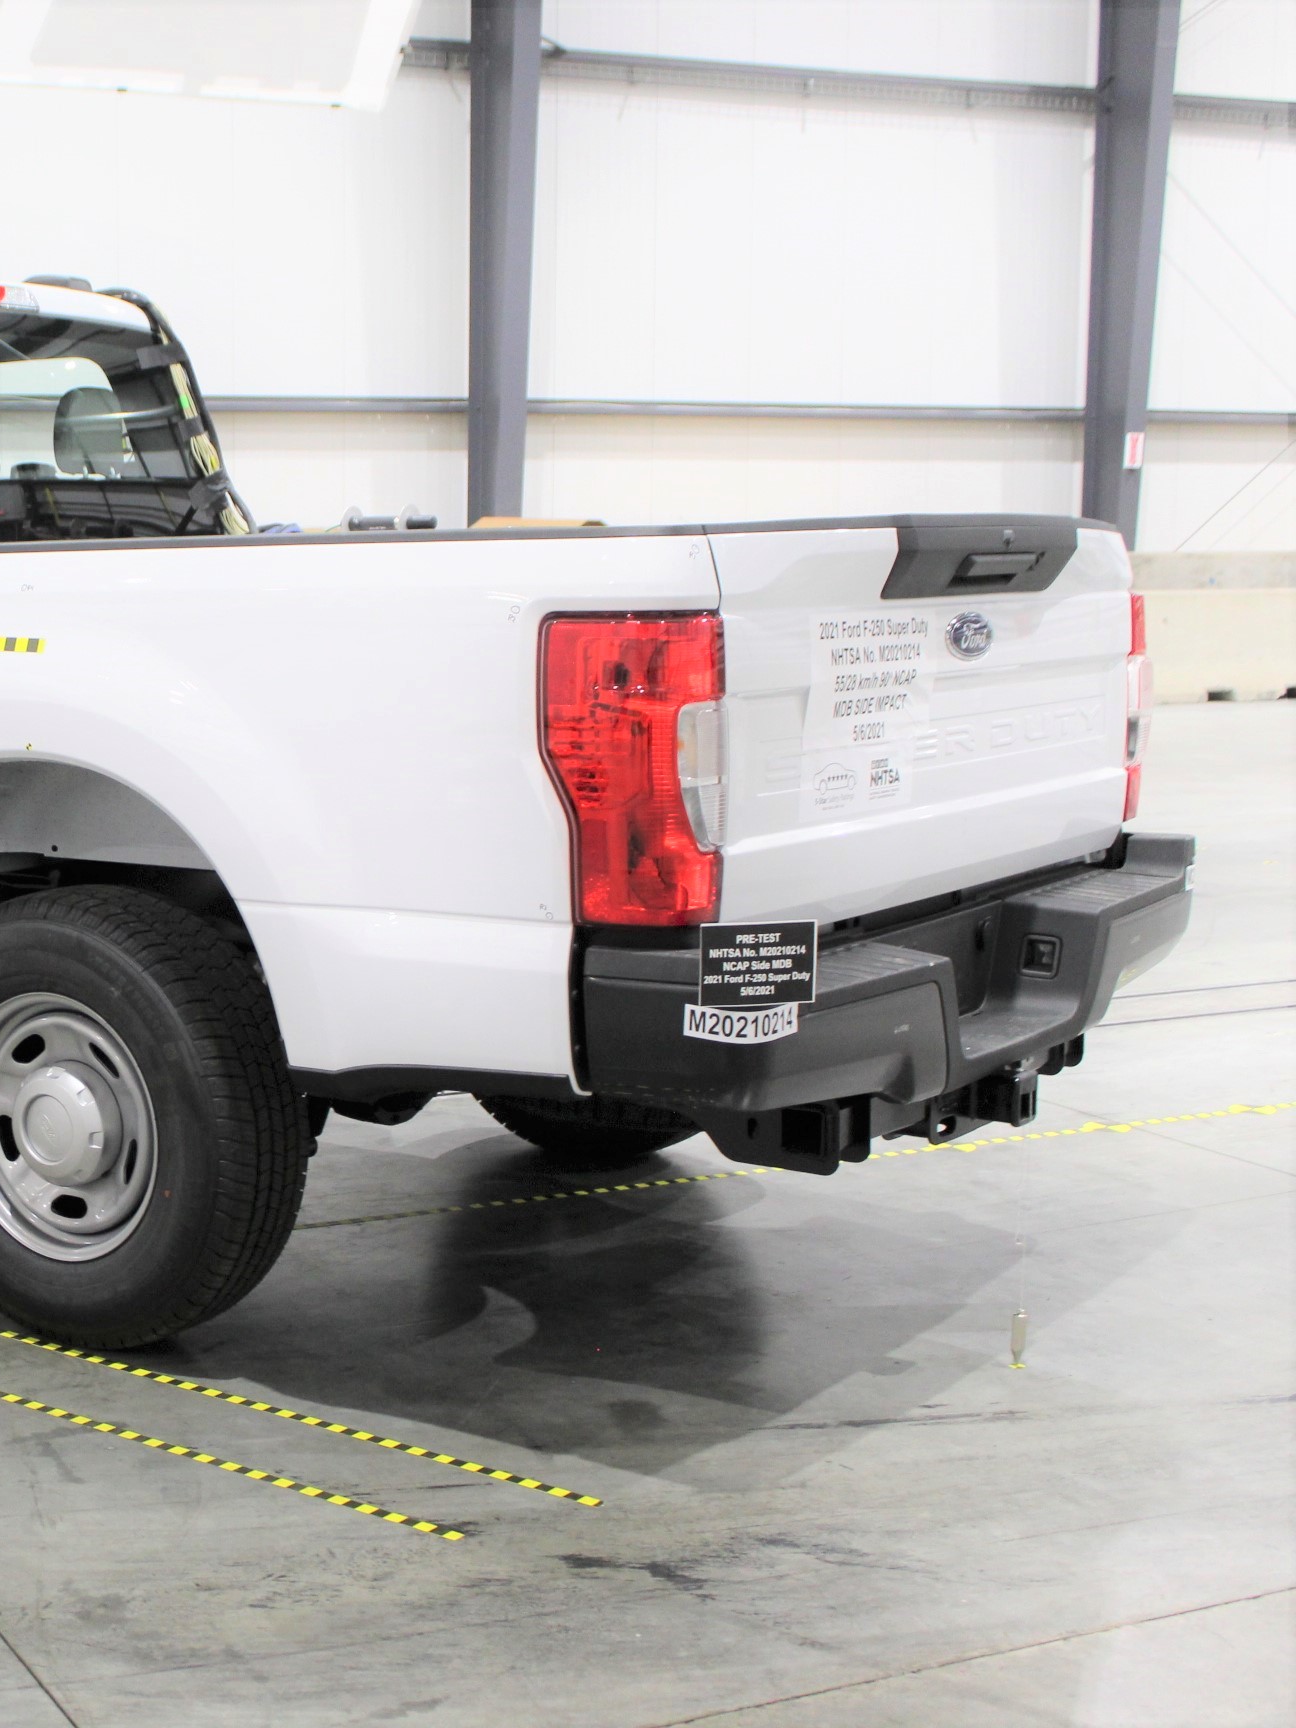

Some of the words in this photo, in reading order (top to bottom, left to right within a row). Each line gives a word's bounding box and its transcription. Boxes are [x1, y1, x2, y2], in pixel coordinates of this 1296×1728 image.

[819, 622, 839, 640] 2021
[842, 620, 861, 639] Ford
[864, 619, 885, 637] F-250
[887, 618, 909, 639] Super
[911, 617, 929, 637] Duty
[953, 618, 990, 652] Ford
[831, 647, 860, 666] NHTSA
[863, 646, 877, 663] No.
[879, 643, 921, 662] M20210214
[857, 672, 879, 690] km/h
[892, 669, 917, 687] NCAP
[833, 700, 854, 718] MDB
[854, 697, 875, 716] SIDE
[874, 694, 908, 713] IMPACT
[853, 722, 885, 741] 5/6/2021
[990, 702, 1101, 750] DUTY
[870, 768, 900, 787] NHTSA
[736, 933, 781, 944] PRE-TEST
[709, 948, 741, 958] NHTSA
[743, 948, 758, 957] No.
[759, 945, 807, 957] M20210214
[723, 961, 749, 971] NCAP
[751, 960, 771, 970] Side
[772, 959, 792, 969] MDB
[703, 975, 723, 984] 2021
[724, 974, 743, 983] Ford
[744, 973, 767, 982] F-250
[768, 973, 791, 983] Super
[791, 971, 811, 982] Duty
[740, 985, 775, 996] 5/6/2021
[688, 1007, 793, 1038] M20210214
